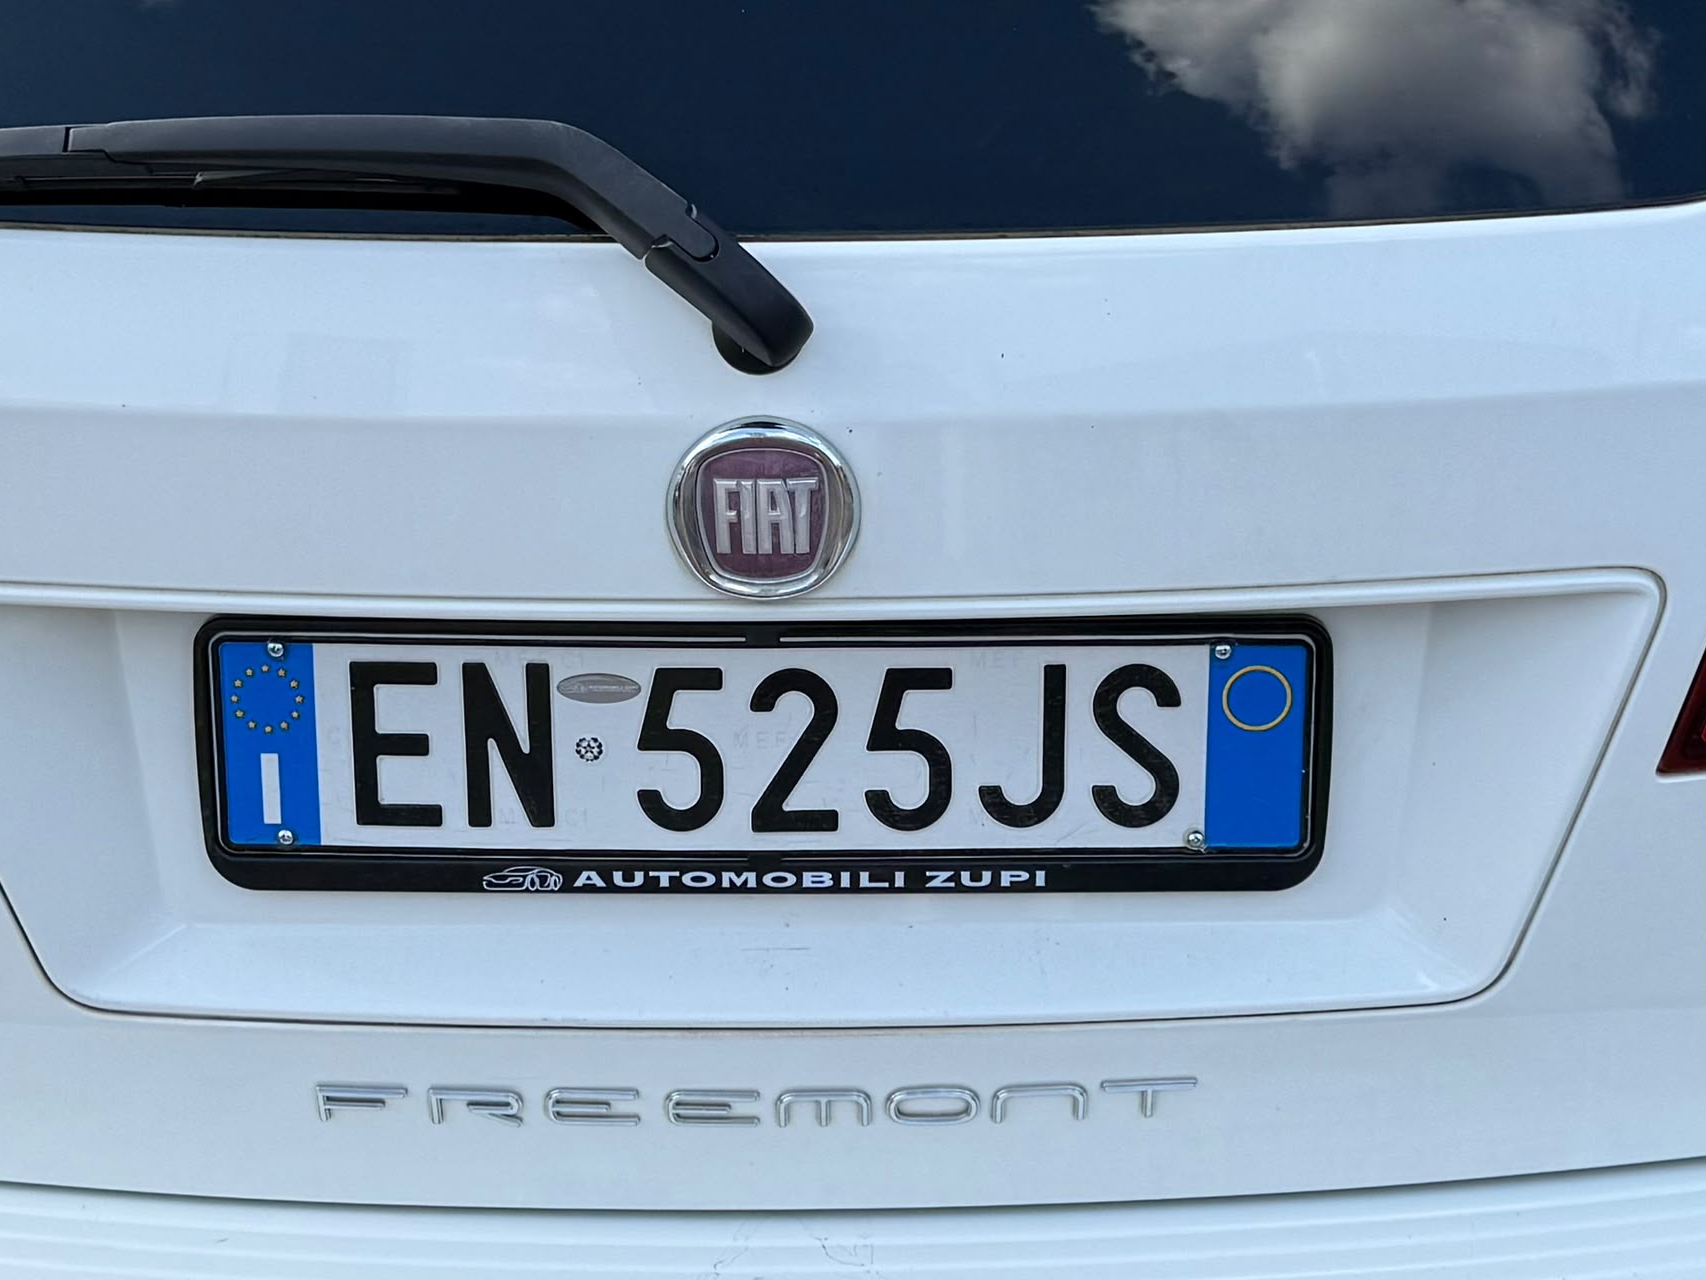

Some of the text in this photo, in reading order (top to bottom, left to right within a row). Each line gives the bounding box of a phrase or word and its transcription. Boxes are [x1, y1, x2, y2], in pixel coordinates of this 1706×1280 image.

[713, 477, 819, 555] FIAT
[348, 660, 553, 830] EN
[635, 663, 1183, 832] 525JS
[573, 869, 1046, 889] AUTOMOBILI ZUPI
[315, 1076, 1199, 1128] FREEMONT
